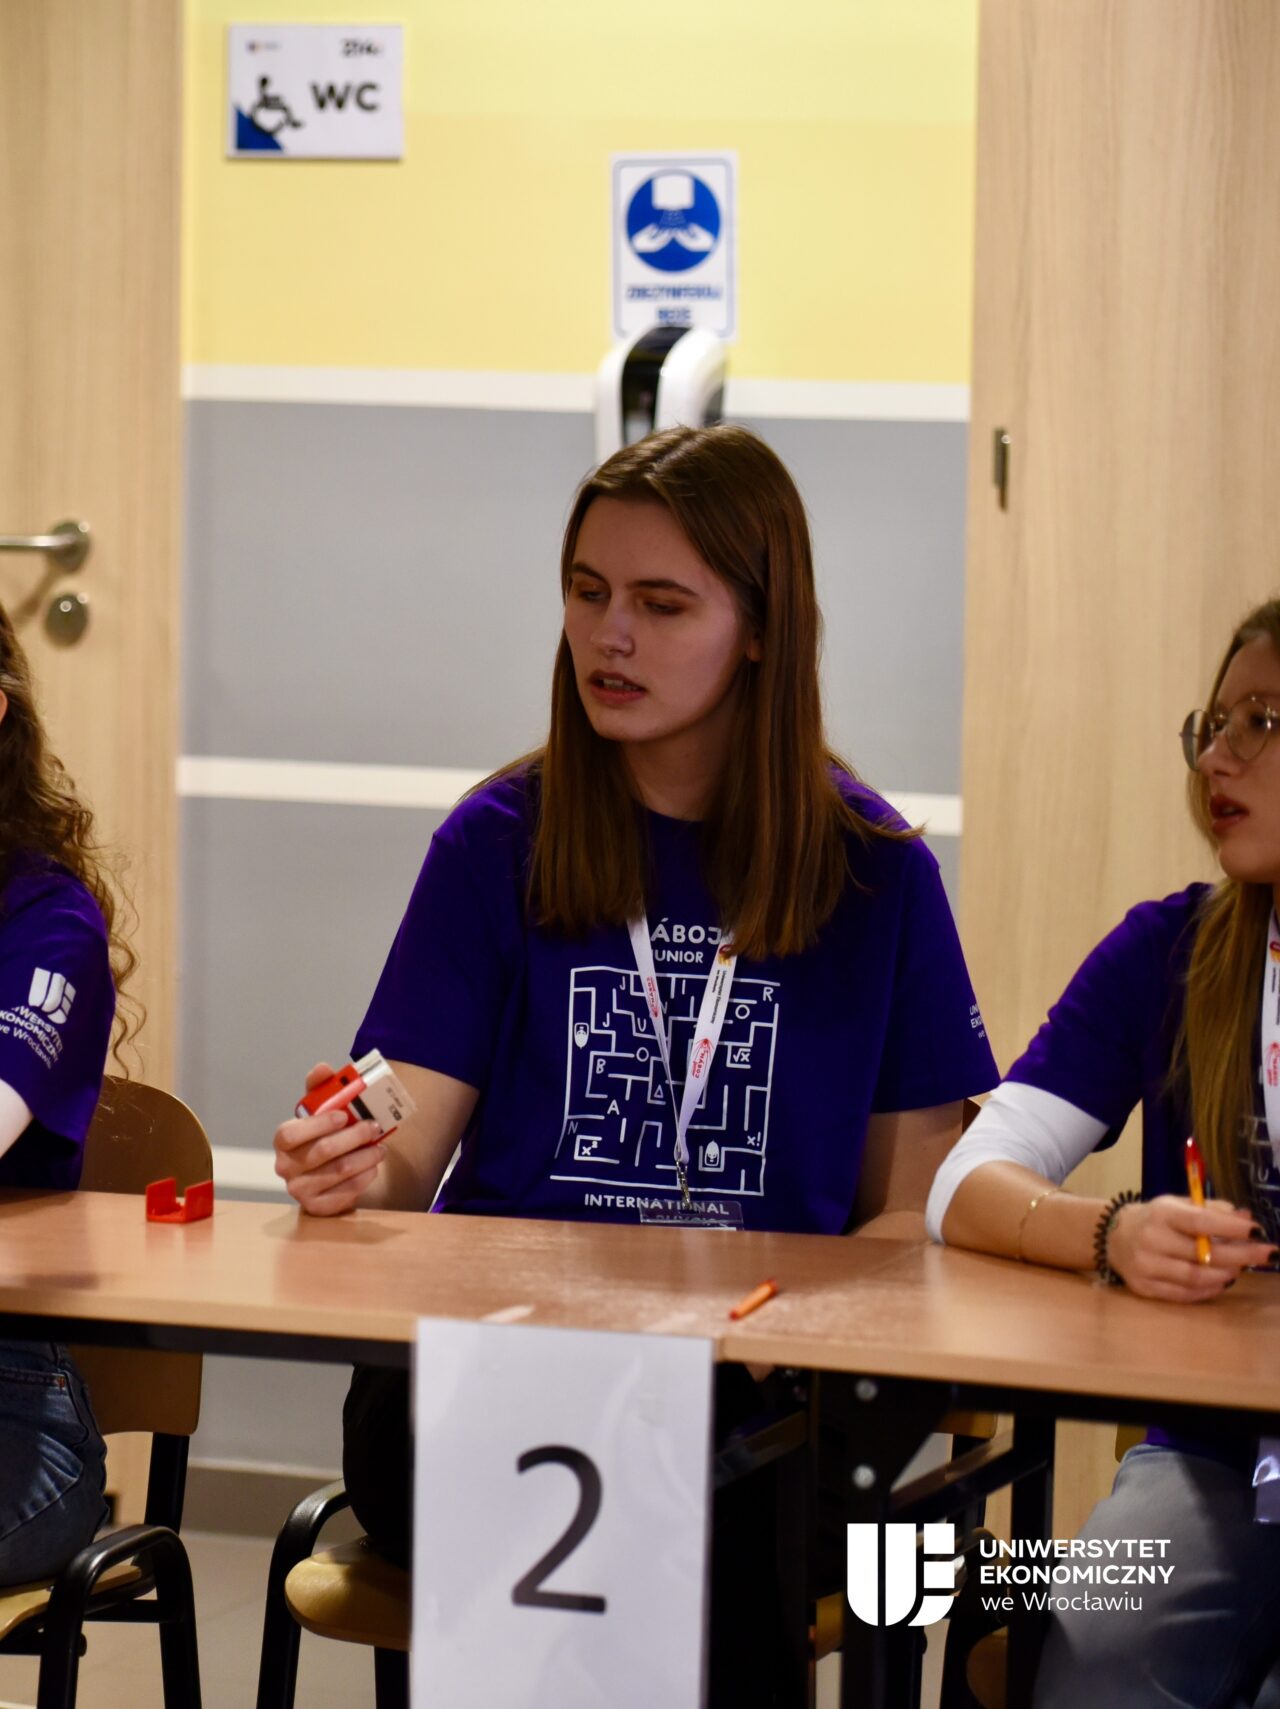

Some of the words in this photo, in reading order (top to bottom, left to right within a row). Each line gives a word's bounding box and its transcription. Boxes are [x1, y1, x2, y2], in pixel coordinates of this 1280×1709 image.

[311, 82, 379, 112] WC
[650, 917, 722, 945] ÁBOJ
[651, 949, 704, 964] UNIOR
[511, 1443, 608, 1616] 2
